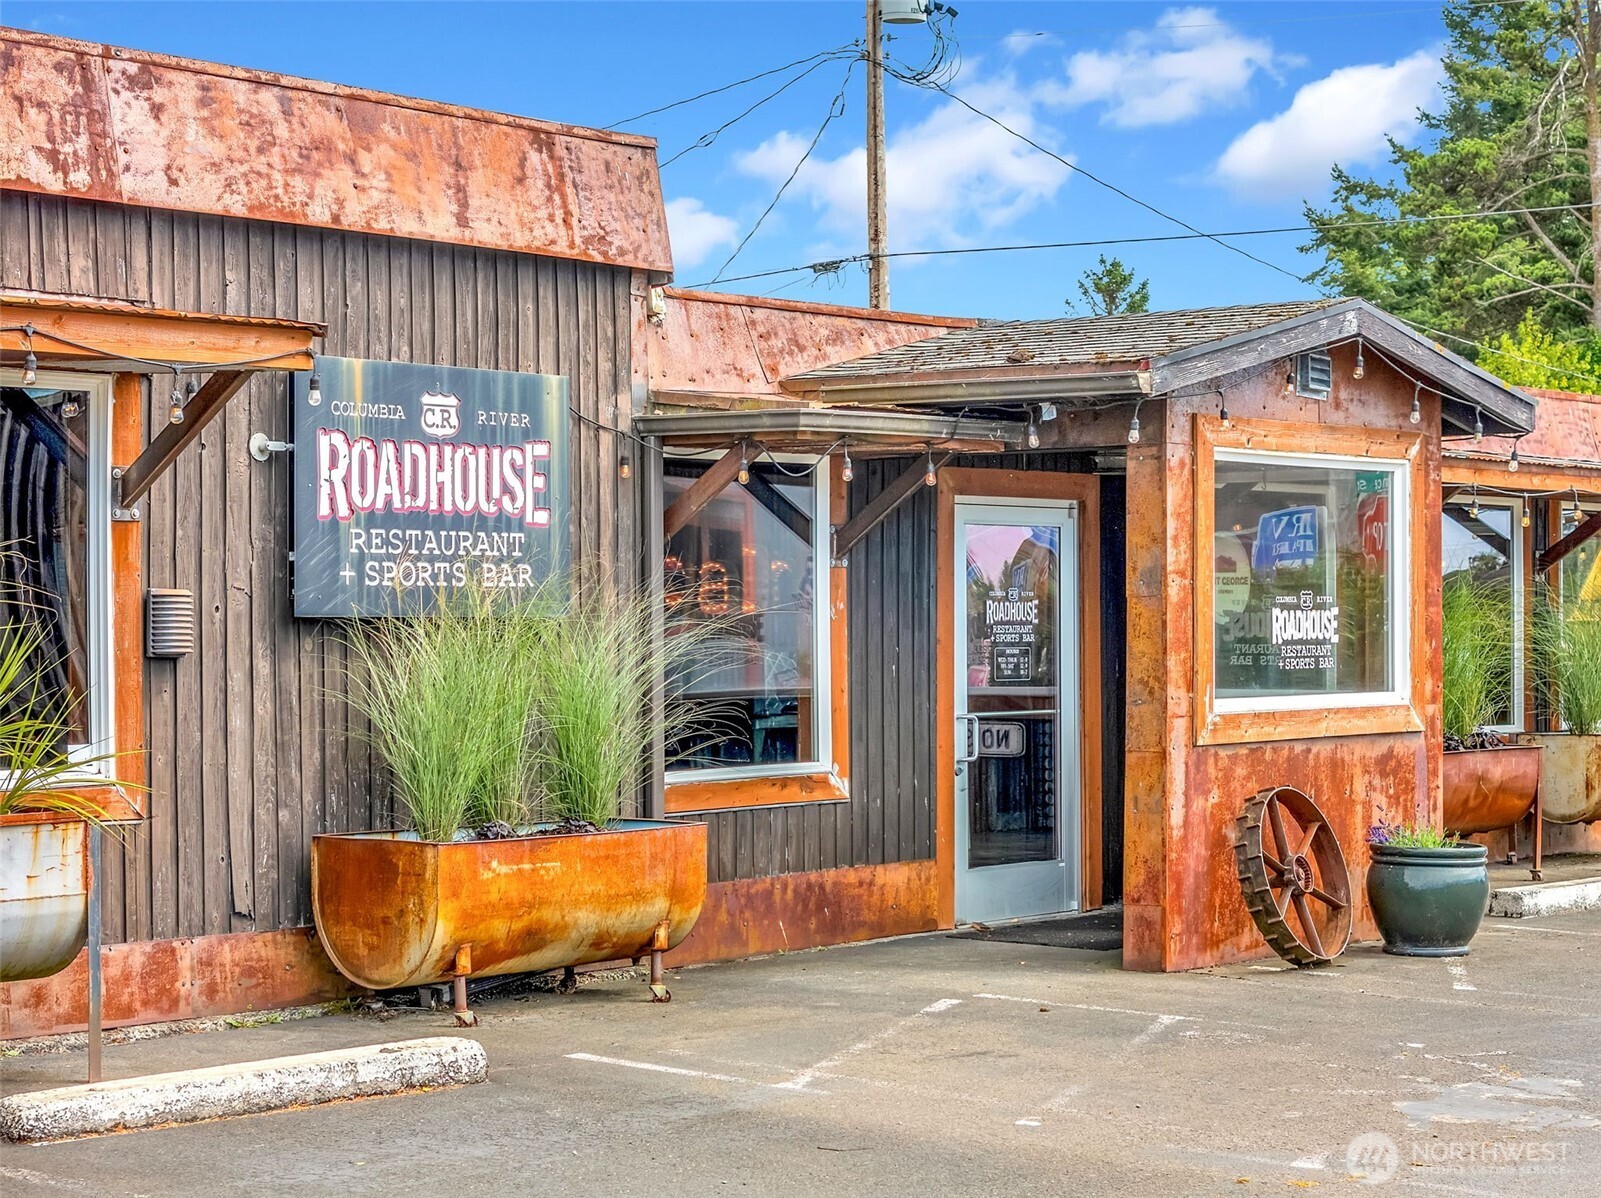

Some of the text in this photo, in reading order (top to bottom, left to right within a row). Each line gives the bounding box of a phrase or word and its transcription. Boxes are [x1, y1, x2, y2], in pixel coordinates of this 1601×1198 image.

[330, 400, 531, 430] COLUMBIA C.R. RIVER
[316, 427, 551, 527] ROADHOUSE
[350, 528, 525, 557] RESTAURANT
[340, 561, 534, 588] + SPORTS BAR
[1221, 576, 1249, 586] GEORGE
[986, 600, 1039, 624] ROADHOUSE
[992, 625, 1033, 634] RESTAURANT
[1272, 607, 1339, 644] ROADHOUSE
[995, 634, 1020, 642] SPORTS
[1022, 634, 1036, 642] BAR
[1281, 645, 1332, 656] RESTAURANT
[1285, 658, 1315, 669] SPORTS
[1319, 657, 1334, 668] BAR
